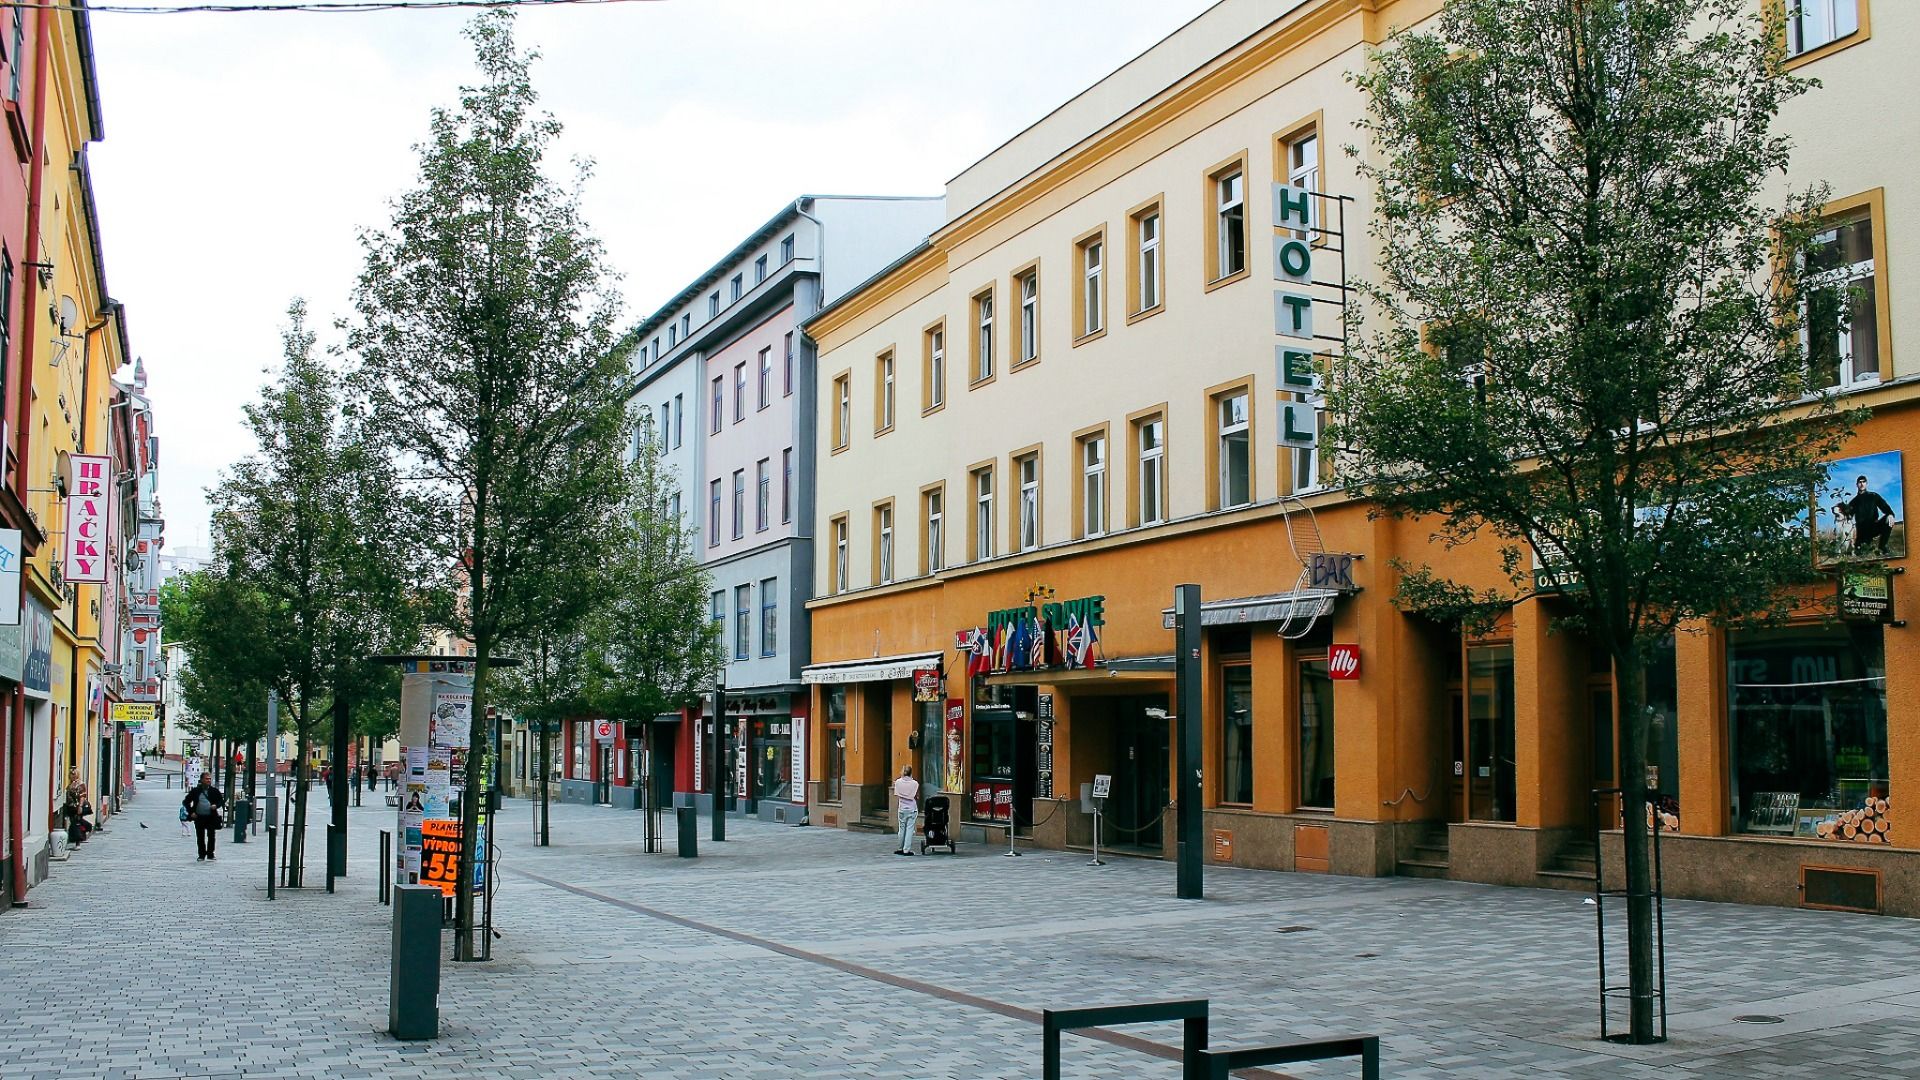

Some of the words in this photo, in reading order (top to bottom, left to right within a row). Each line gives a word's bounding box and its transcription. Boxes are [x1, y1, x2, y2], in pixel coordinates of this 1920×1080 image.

[1280, 188, 1314, 441] HOTEL
[75, 462, 102, 575] HRAČKY
[1315, 555, 1352, 585] BAR
[988, 606, 1037, 644] HOTEL
[1331, 650, 1357, 676] illy
[423, 836, 462, 852] VÝPROD
